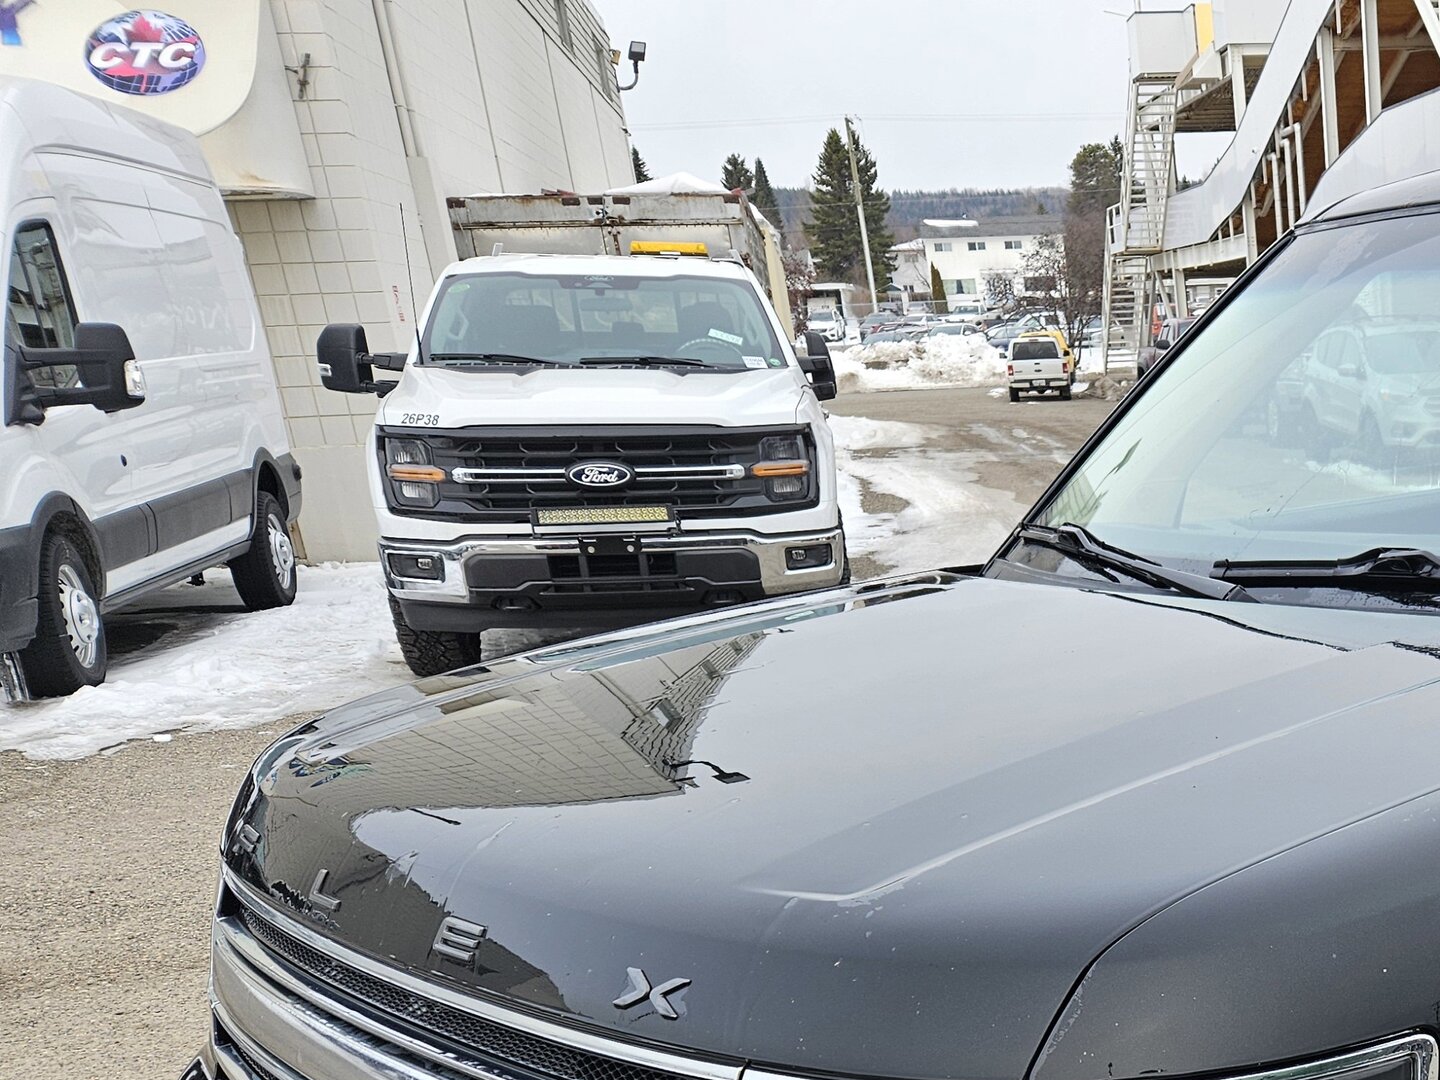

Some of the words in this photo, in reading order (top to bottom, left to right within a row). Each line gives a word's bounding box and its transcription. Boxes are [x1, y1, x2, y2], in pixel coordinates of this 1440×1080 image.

[89, 42, 197, 70] CTC
[401, 412, 440, 427] 26P38
[581, 467, 619, 484] Ford
[232, 823, 693, 1020] FLEX
